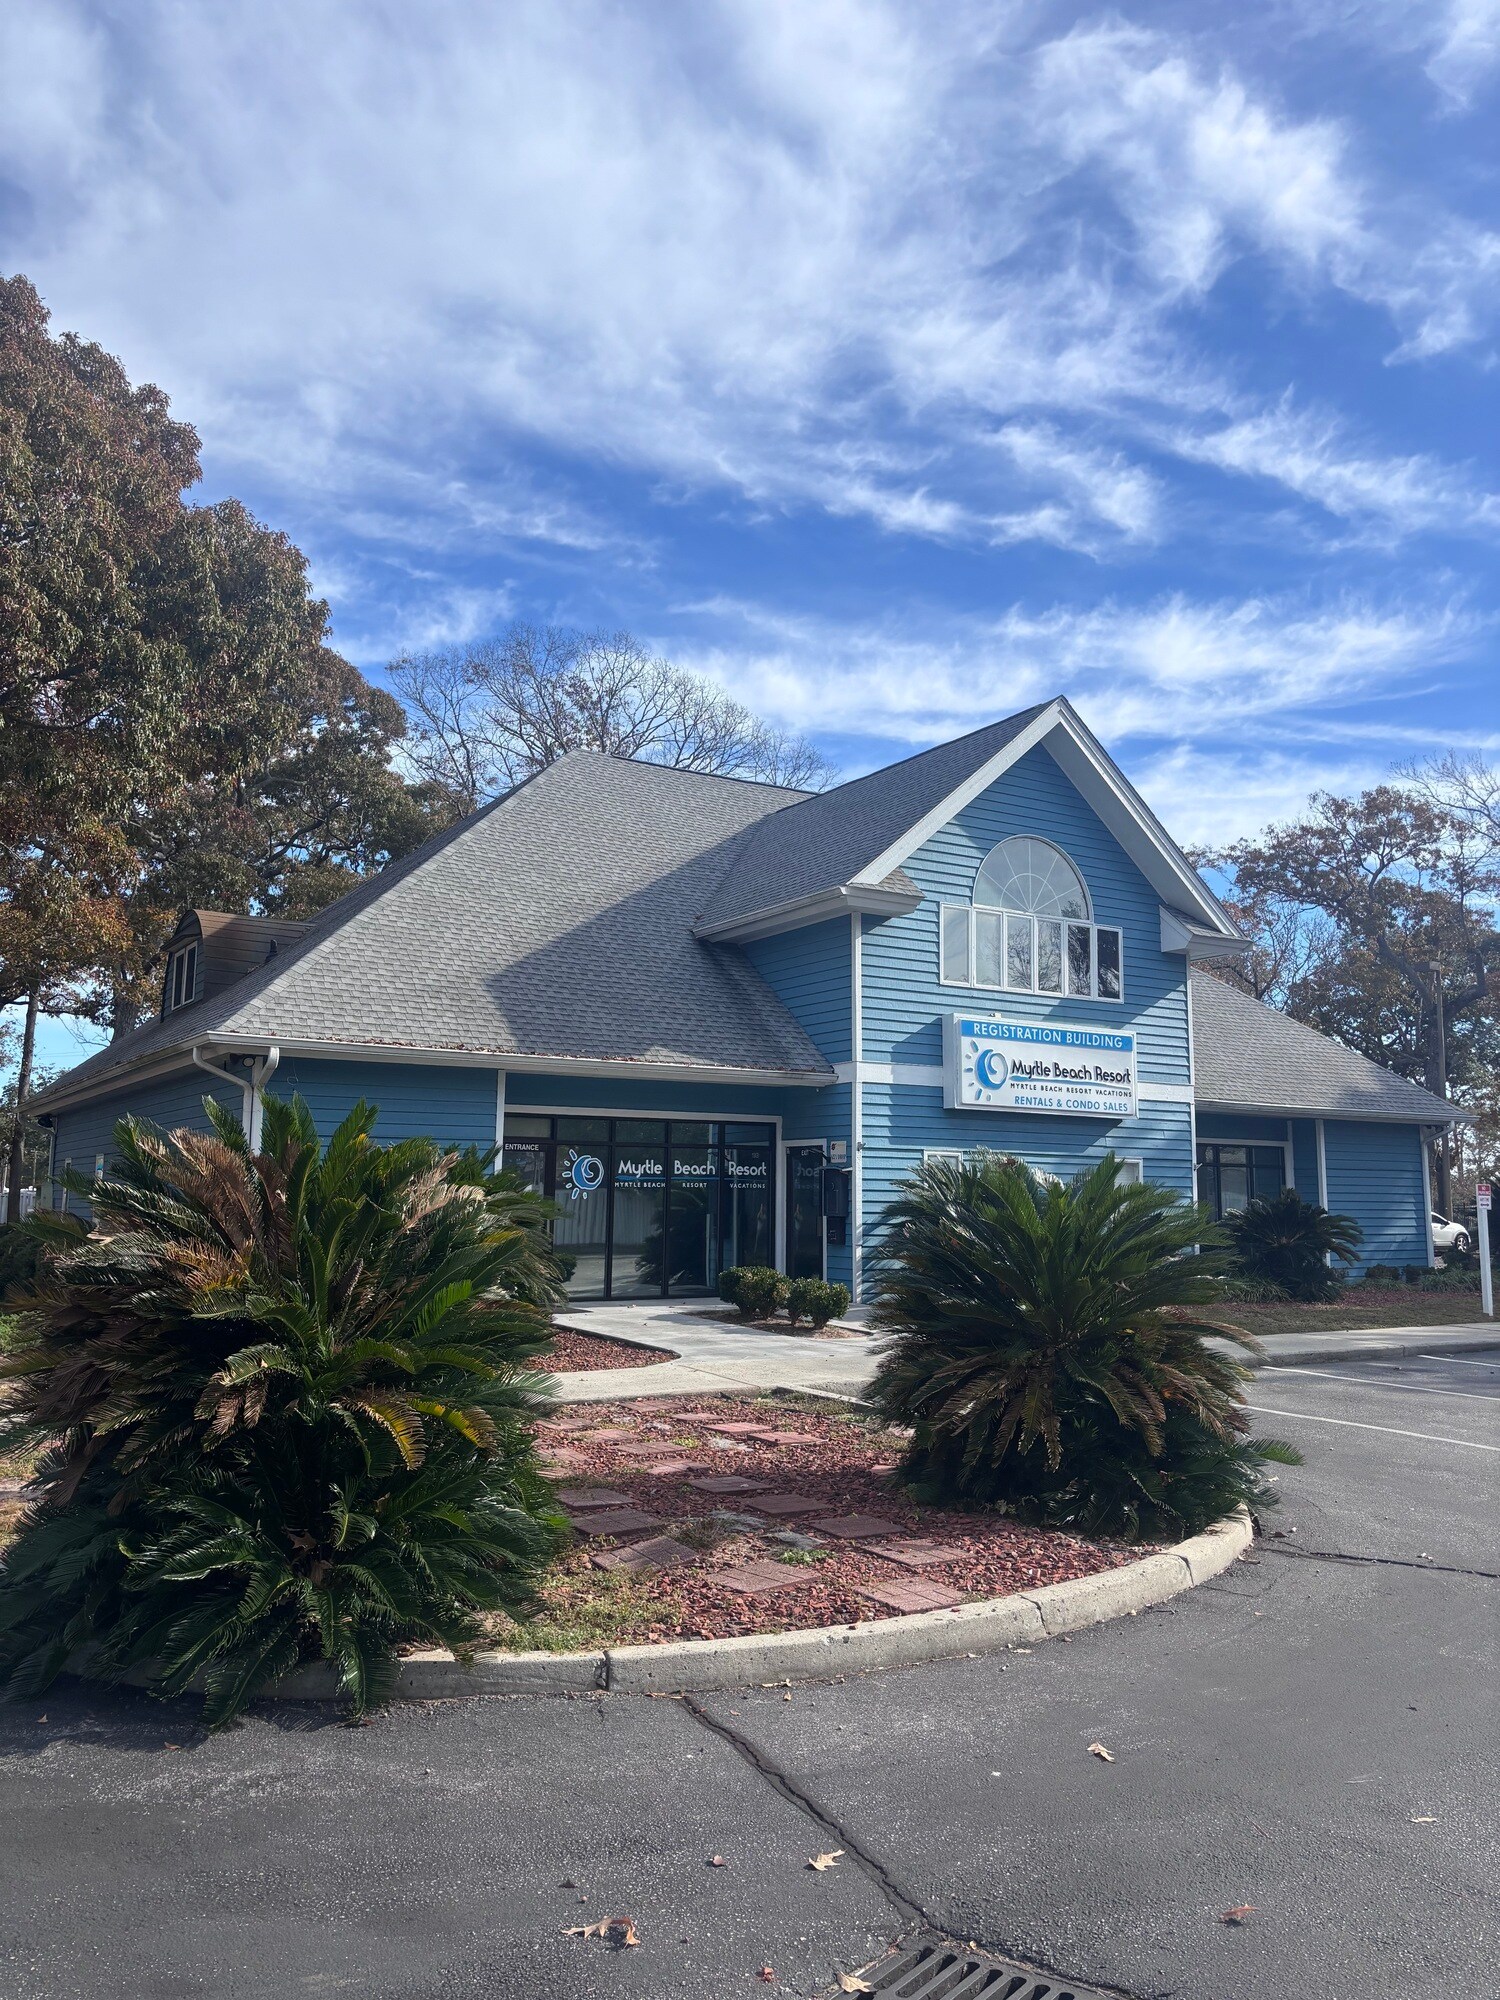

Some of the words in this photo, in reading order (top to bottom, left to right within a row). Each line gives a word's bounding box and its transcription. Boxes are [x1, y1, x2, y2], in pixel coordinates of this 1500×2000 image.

[973, 1022, 1062, 1043] REGISTRATION
[1066, 1032, 1123, 1048] BUILDING
[1010, 1059, 1051, 1079] Myrtle
[1053, 1061, 1092, 1080] Beach
[1093, 1065, 1131, 1083] Resort
[1010, 1082, 1037, 1091] MYRTLE
[1040, 1085, 1063, 1093] BEACH
[1066, 1086, 1092, 1095] RESORT
[1095, 1089, 1132, 1097] VACATIONS
[1014, 1095, 1053, 1107] RENTALS
[1056, 1098, 1063, 1108] &
[1066, 1099, 1100, 1110] CONDO
[1103, 1101, 1128, 1112] SALES
[504, 1143, 540, 1151] ENTRANCE
[618, 1159, 663, 1178] Myrtle
[674, 1160, 716, 1175] Beach
[728, 1161, 767, 1176] Resort
